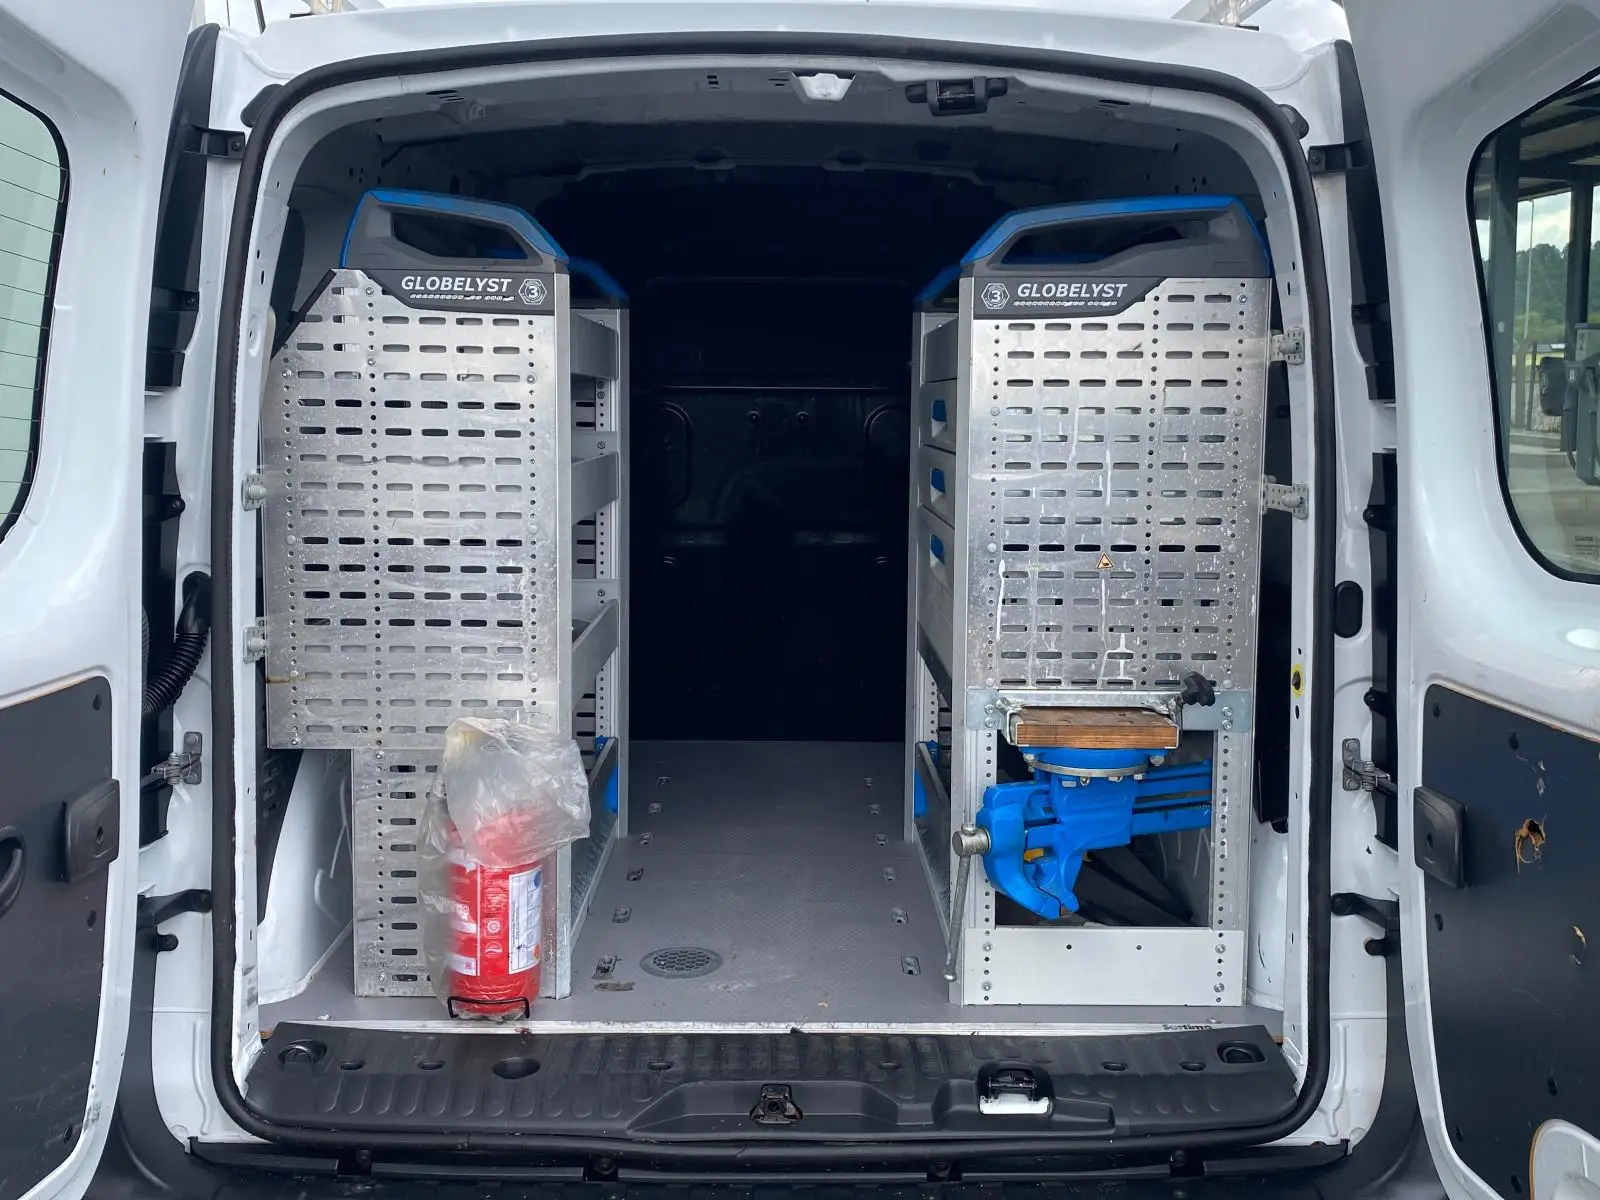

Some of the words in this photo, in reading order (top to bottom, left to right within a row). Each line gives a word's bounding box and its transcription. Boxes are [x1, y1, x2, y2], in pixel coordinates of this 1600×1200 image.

[401, 276, 512, 292] GLOBELYST
[1017, 283, 1128, 298] GLOBELYST
[528, 285, 539, 298] 3
[990, 289, 1001, 302] 3
